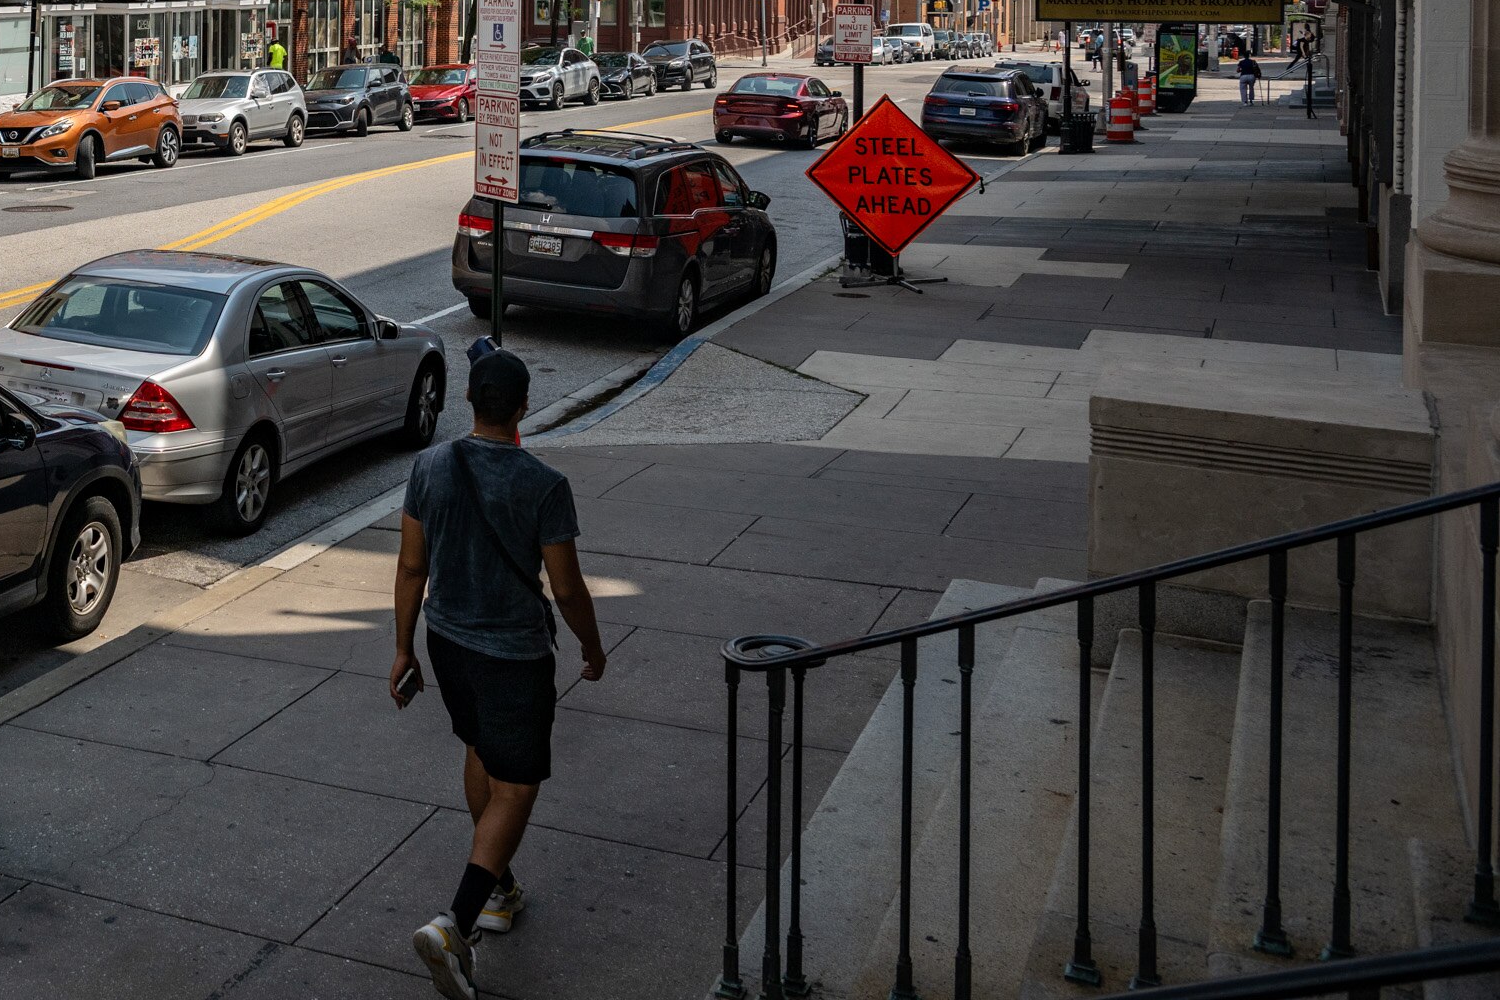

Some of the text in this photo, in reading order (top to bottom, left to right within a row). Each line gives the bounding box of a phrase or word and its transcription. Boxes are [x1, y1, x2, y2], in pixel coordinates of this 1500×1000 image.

[837, 7, 871, 16] PARKING
[851, 15, 856, 24] 3
[844, 31, 863, 39] LIMIT
[479, 98, 515, 114] PARKING
[479, 113, 516, 126] BY PERMIT ONLY
[489, 132, 503, 148] NOT
[855, 137, 924, 157] STEEL
[479, 152, 514, 171] IN EFFECT
[848, 165, 933, 186] PLATES
[477, 184, 516, 199] TOW AWAY ZONE
[855, 195, 932, 216] AHEAD
